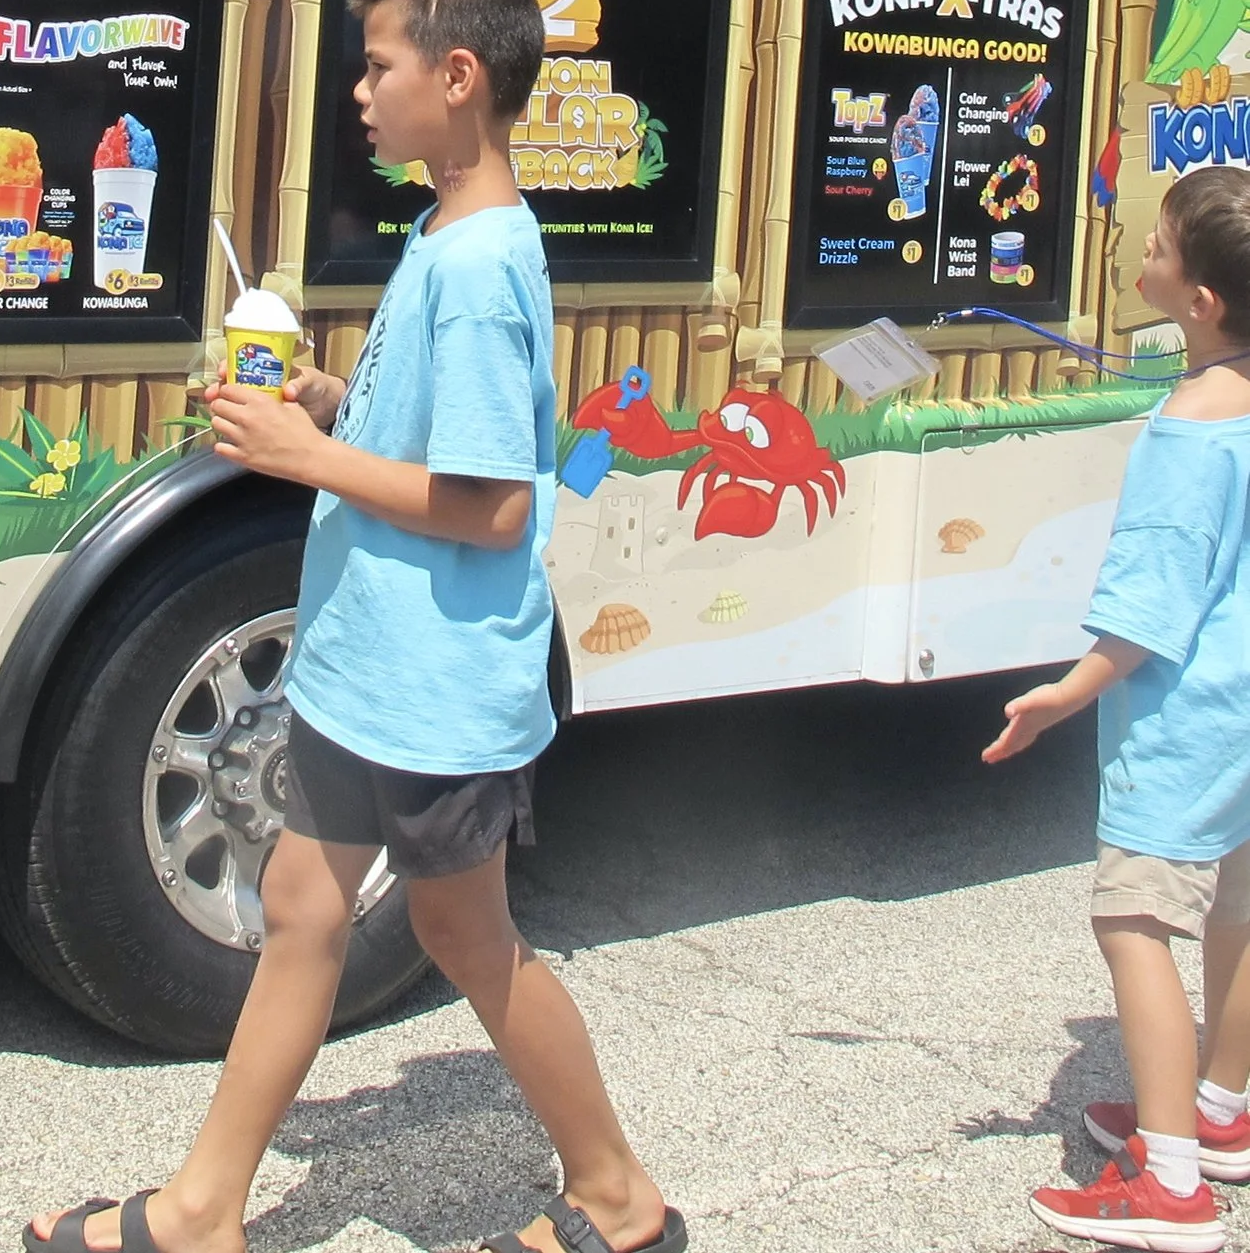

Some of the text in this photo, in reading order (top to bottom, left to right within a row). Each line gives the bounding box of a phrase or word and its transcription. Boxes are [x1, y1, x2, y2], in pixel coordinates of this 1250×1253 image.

[843, 31, 1048, 64] KOWABUNGA GOOD!
[108, 56, 127, 70] and
[533, 57, 612, 94] ION
[959, 93, 987, 105] Color
[958, 108, 1009, 123] Changing
[957, 122, 991, 136] Spoon
[1151, 100, 1250, 173] KON
[827, 156, 866, 166] Sour Blue
[954, 160, 991, 173] Flower
[826, 167, 868, 178] Raspberry
[953, 175, 970, 187] Lei
[825, 185, 874, 196] Sour Cherry
[541, 223, 585, 233] RTUNITIES
[819, 237, 895, 250] Sweet Cream
[950, 236, 977, 249] Kona
[819, 252, 859, 264] Drizzle
[948, 251, 977, 263] Wrist
[947, 265, 976, 277] Band
[108, 273, 124, 290] $6
[6, 297, 49, 309] CHANGE
[82, 297, 149, 309] KOWABUNGA
